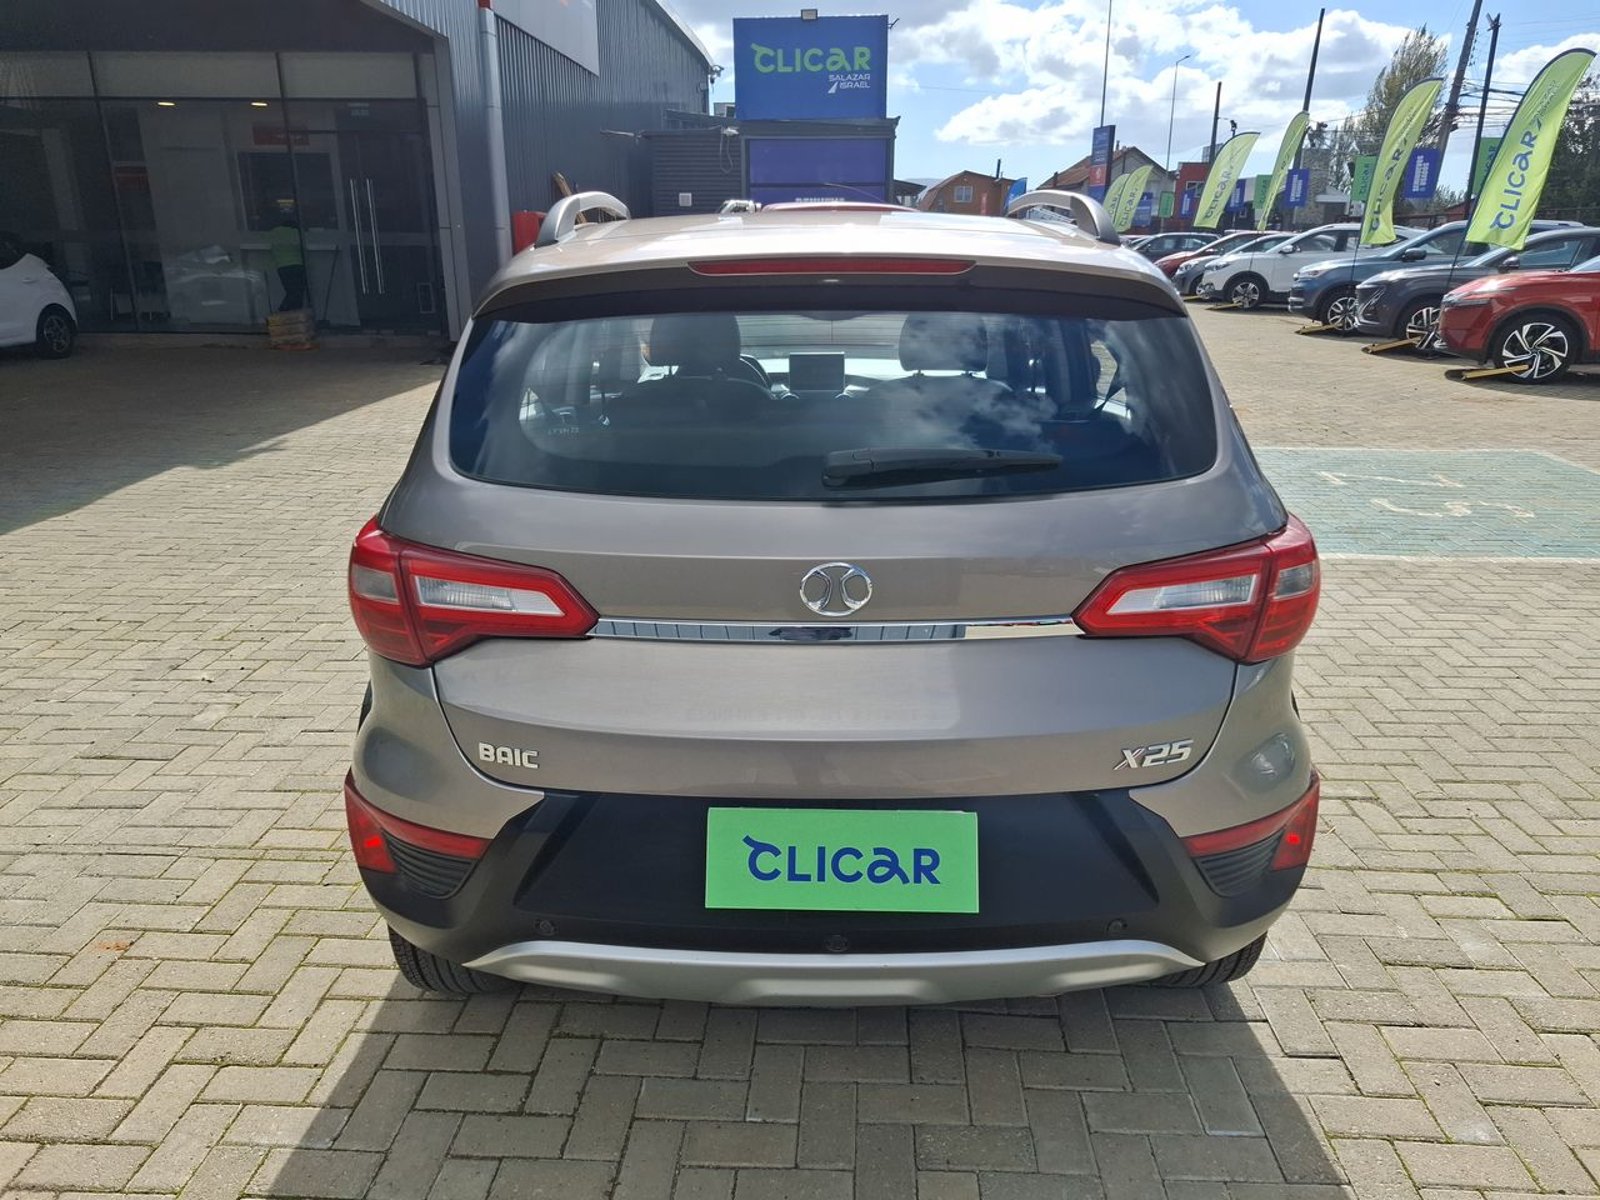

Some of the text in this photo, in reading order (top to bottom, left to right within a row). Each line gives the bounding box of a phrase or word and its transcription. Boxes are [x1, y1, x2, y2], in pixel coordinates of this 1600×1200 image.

[828, 73, 871, 82] SALAZAR
[839, 81, 871, 89] ISRAEL
[479, 742, 538, 769] BAIC
[1113, 740, 1194, 770] X25
